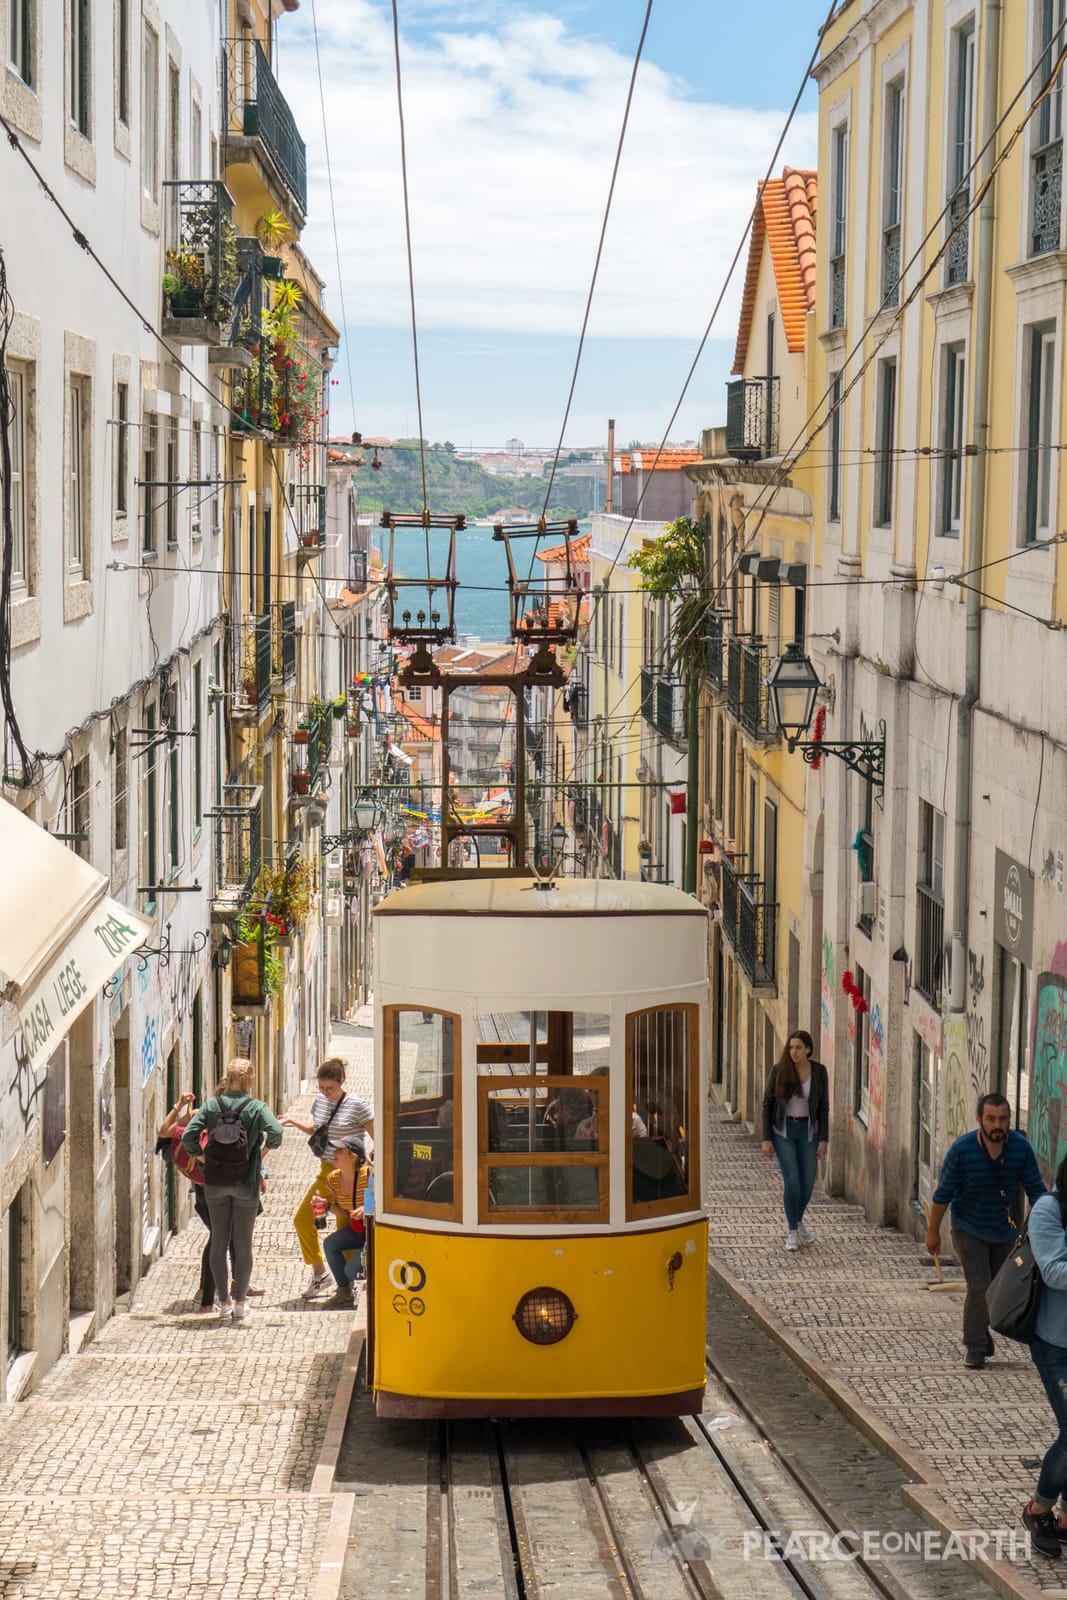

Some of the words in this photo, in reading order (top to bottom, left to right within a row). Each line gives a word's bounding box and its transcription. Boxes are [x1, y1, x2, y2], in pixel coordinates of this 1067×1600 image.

[24, 997, 55, 1058] CASA
[53, 958, 88, 1017] LIEGE
[406, 1320, 412, 1337] 1
